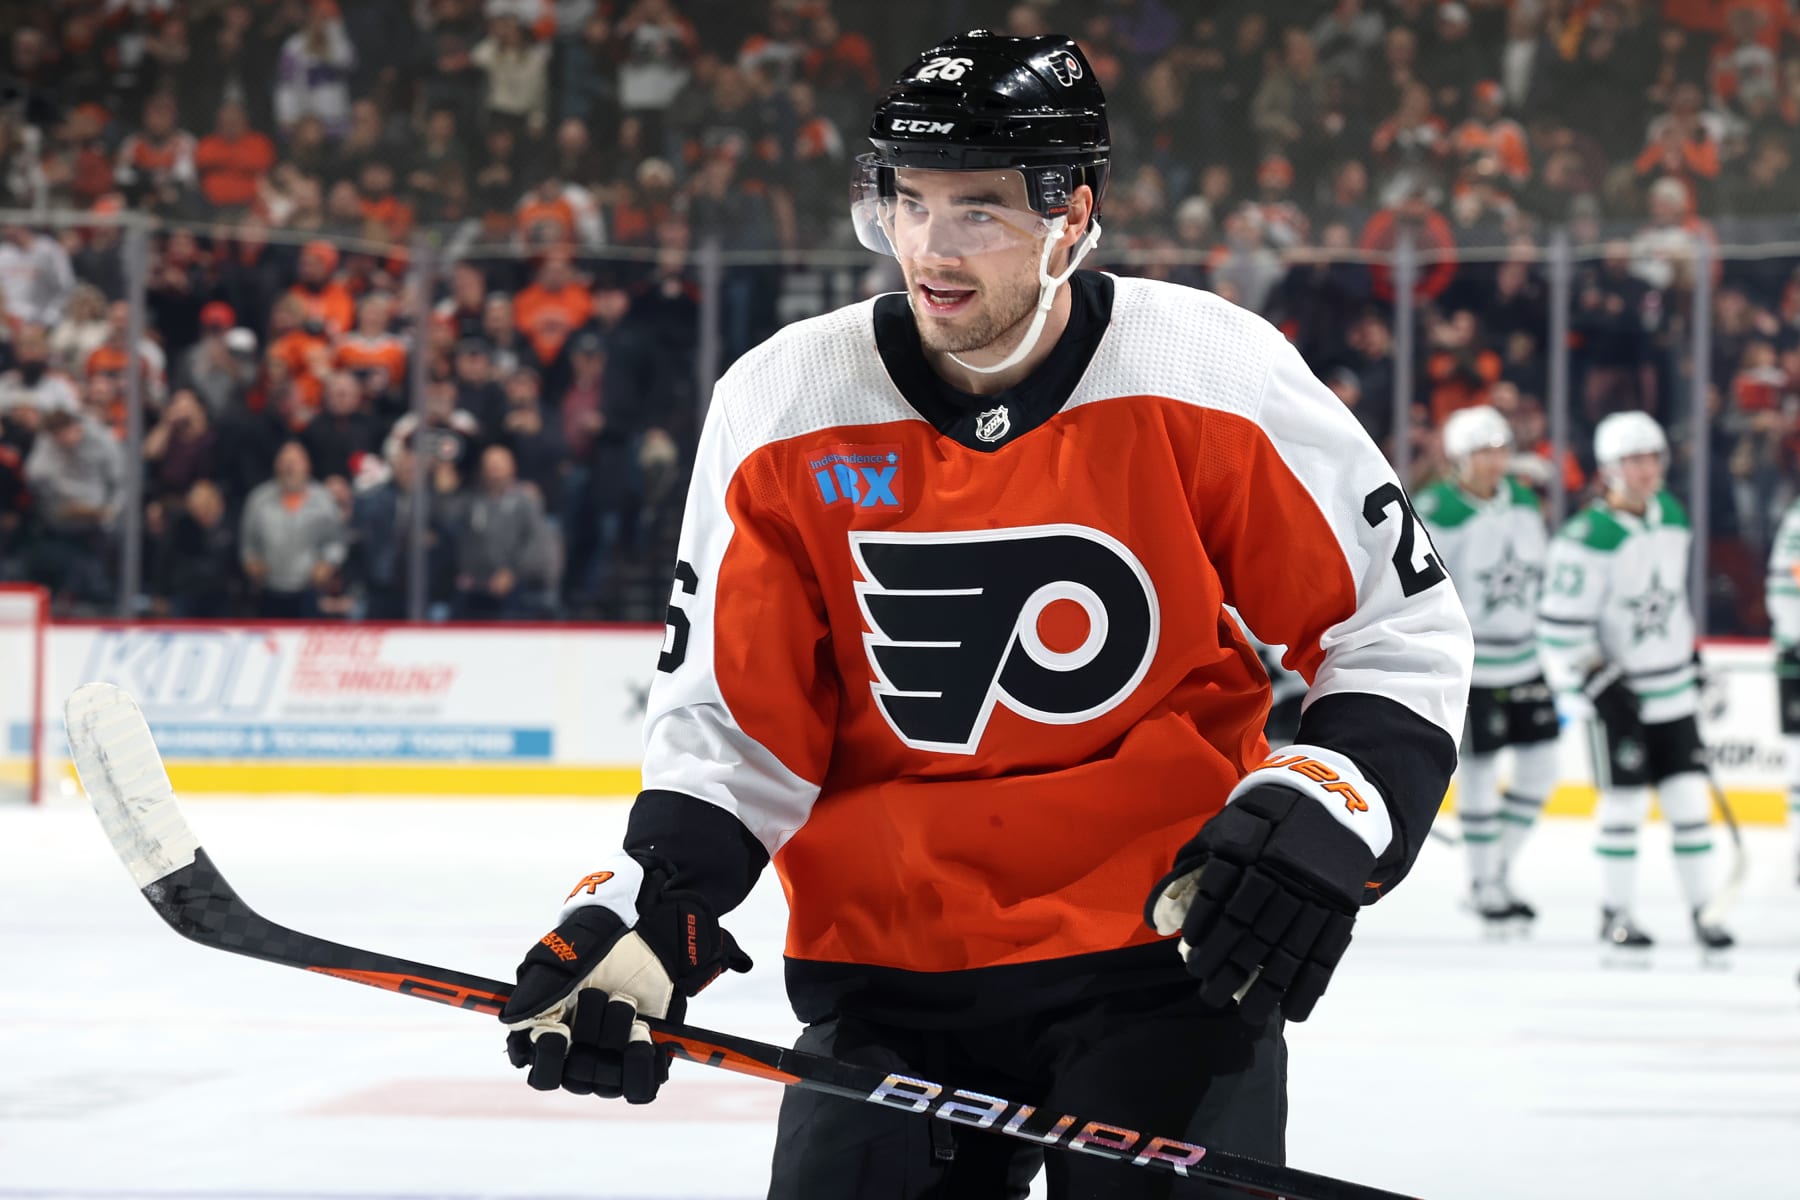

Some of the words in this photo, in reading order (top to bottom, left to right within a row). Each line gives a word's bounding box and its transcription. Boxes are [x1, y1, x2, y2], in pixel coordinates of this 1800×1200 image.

[915, 57, 974, 81] 26
[890, 117, 955, 135] CCM
[810, 452, 883, 470] Independence
[815, 463, 899, 508] IBX
[1362, 482, 1448, 598] 2
[866, 1072, 1206, 1177] BAUER
